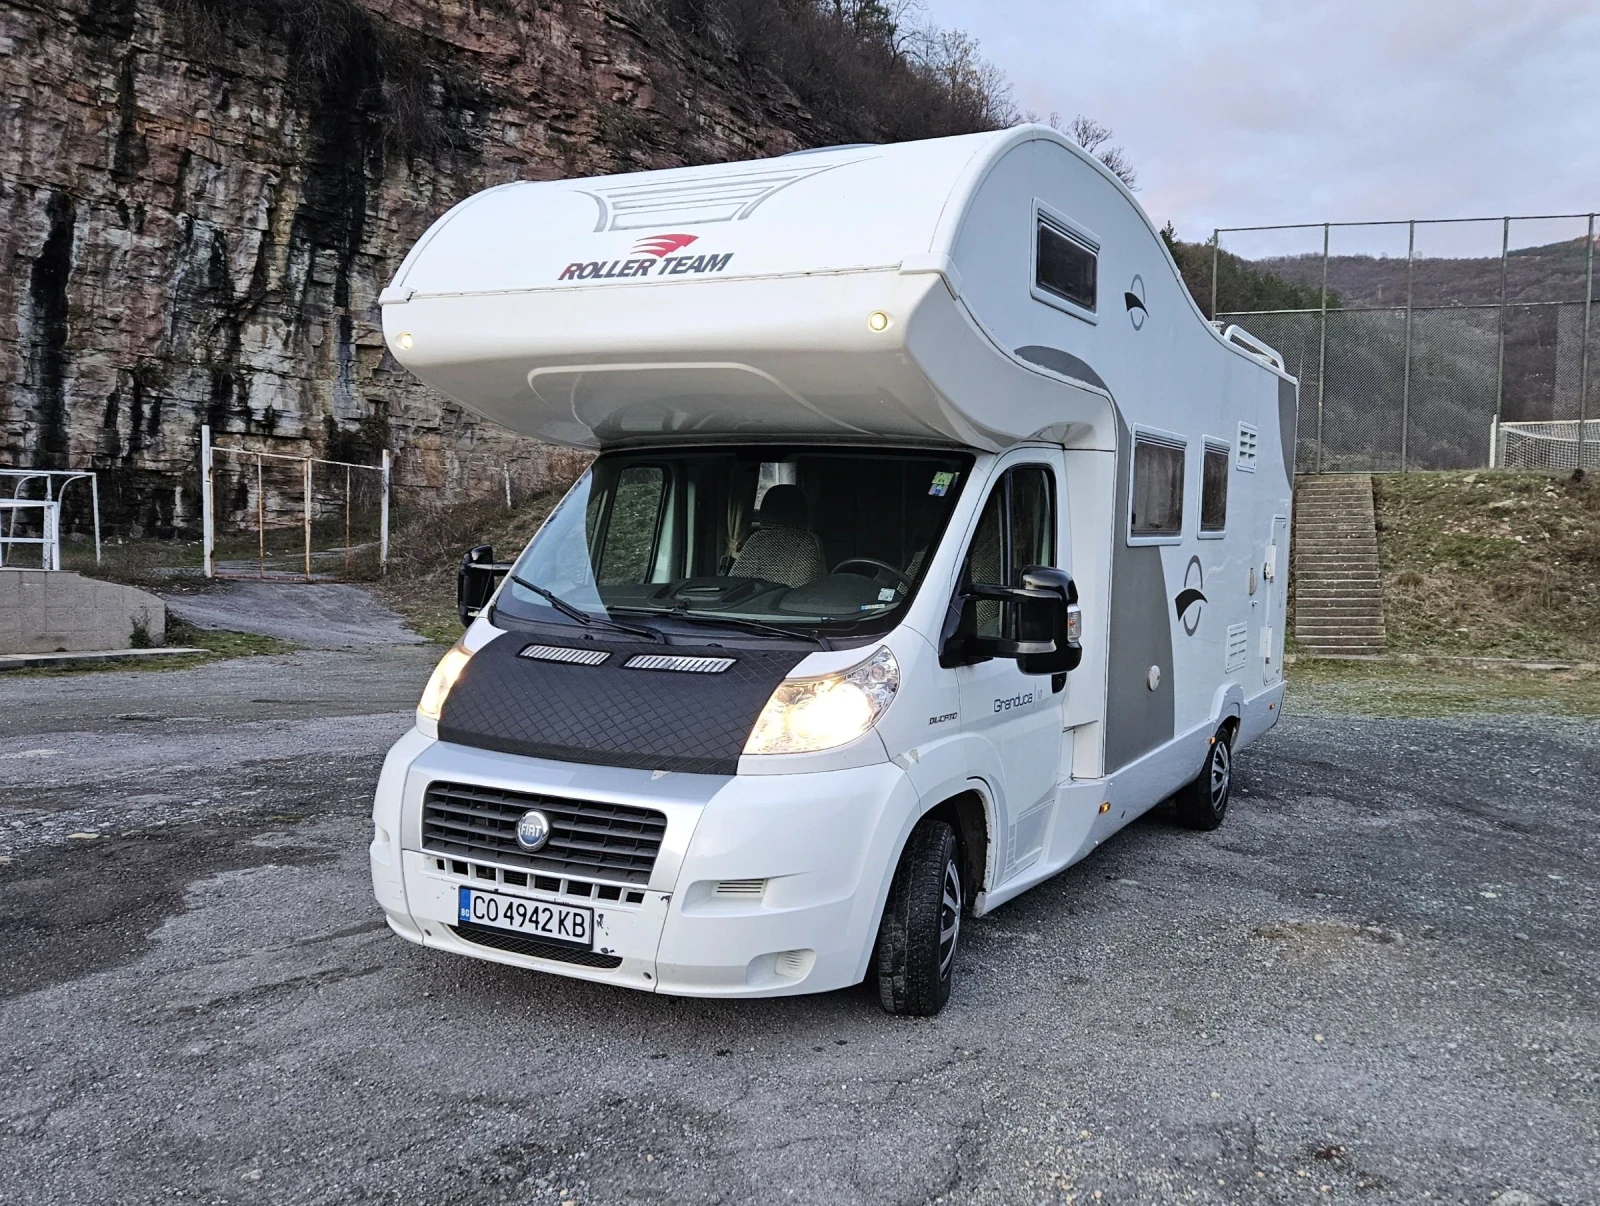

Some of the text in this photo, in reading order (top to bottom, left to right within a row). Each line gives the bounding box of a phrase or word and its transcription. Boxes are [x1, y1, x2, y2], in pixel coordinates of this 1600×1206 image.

[557, 252, 735, 280] ROLLER TEAM
[993, 692, 1033, 713] Granduca
[520, 823, 542, 837] FIAT
[460, 908, 470, 918] BG
[473, 895, 586, 938] CO 4942 KB
